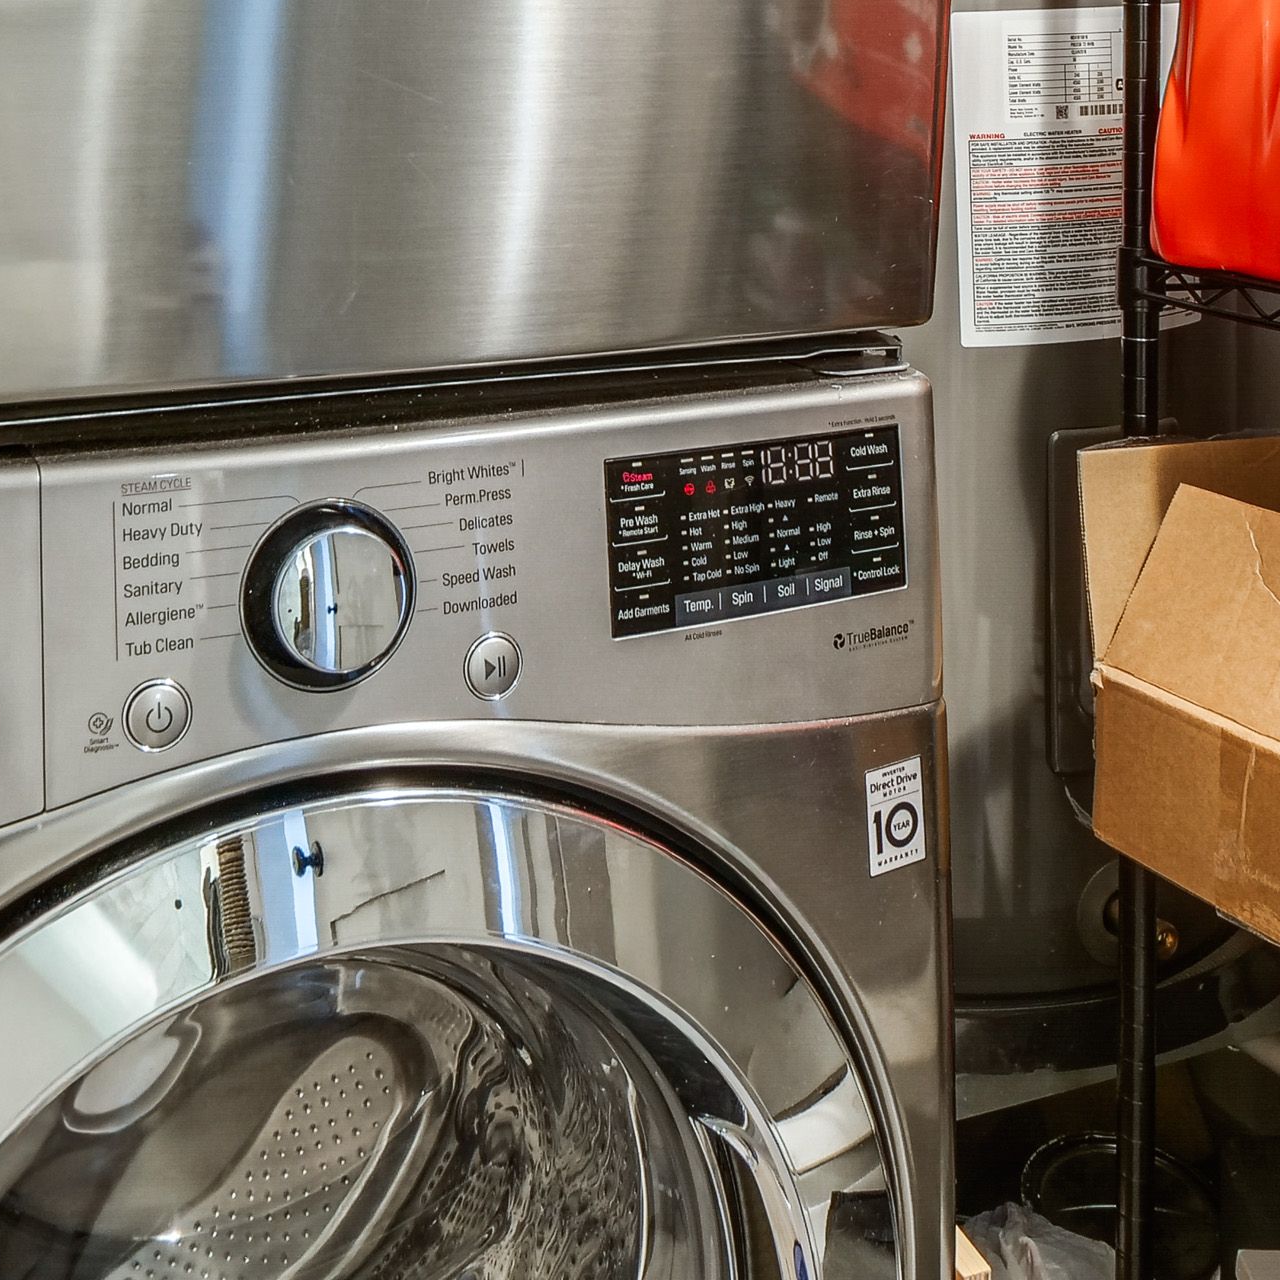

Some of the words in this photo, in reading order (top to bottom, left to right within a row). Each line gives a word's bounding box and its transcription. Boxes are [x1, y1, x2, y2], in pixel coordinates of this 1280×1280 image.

[850, 446, 866, 457] Cold
[867, 444, 887, 455] Wash
[700, 465, 716, 473] Wash
[742, 459, 754, 468] Spin
[428, 468, 462, 486] Bright
[632, 472, 653, 482] Steam
[121, 479, 152, 494] STEAM
[154, 477, 192, 491] CYCLE
[641, 482, 654, 490] Care
[814, 493, 838, 503] Remote
[853, 489, 871, 499] Extra
[872, 486, 891, 496] Rinse
[121, 499, 172, 517] Normal
[731, 505, 748, 515] Extra
[749, 502, 765, 513] High
[775, 499, 796, 509] Heavy
[459, 513, 513, 531] Delicates
[620, 518, 634, 527] Pre
[635, 514, 658, 526] Wash
[689, 511, 707, 522] Extra
[708, 509, 720, 518] Hot
[122, 524, 168, 542] Heavy
[171, 520, 203, 539] Duty
[644, 526, 658, 535] Start
[689, 527, 702, 536] Hot
[731, 520, 748, 530] High
[816, 522, 831, 532] High
[777, 527, 801, 538] Normal
[854, 530, 872, 541] Rinse
[879, 526, 895, 538] Spin
[691, 541, 712, 551] Warm
[733, 534, 759, 545] Medium
[817, 537, 832, 546] Low
[472, 539, 515, 556] Towels
[122, 551, 180, 571] Bedding
[691, 556, 707, 566] Cold
[733, 551, 748, 559] Low
[818, 552, 828, 561] Off
[618, 561, 640, 573] Delay
[641, 557, 665, 568] Wash
[734, 565, 743, 575] No
[744, 563, 760, 573] Spin
[779, 558, 795, 568] Light
[442, 569, 480, 588] Speed
[482, 564, 517, 581] Wash
[693, 572, 705, 583] Tap
[706, 569, 722, 579] Cold
[858, 570, 883, 581] Control
[884, 565, 900, 576] Lock
[123, 579, 183, 599] Sanitary
[683, 599, 715, 613] Temp.
[732, 591, 753, 606] Spin
[777, 584, 795, 597] Soil
[814, 575, 843, 591] Signal
[443, 591, 518, 615] Downloaded
[618, 610, 634, 620] Add
[635, 604, 670, 617] Garments
[126, 638, 152, 657] Tub
[154, 636, 194, 654] Clean
[870, 778, 894, 794] Direct
[895, 772, 918, 787] Drive
[882, 786, 907, 798] MOTOR
[873, 801, 919, 855] 10
[893, 819, 910, 832] YEAR
[877, 848, 919, 867] WARRANTY
